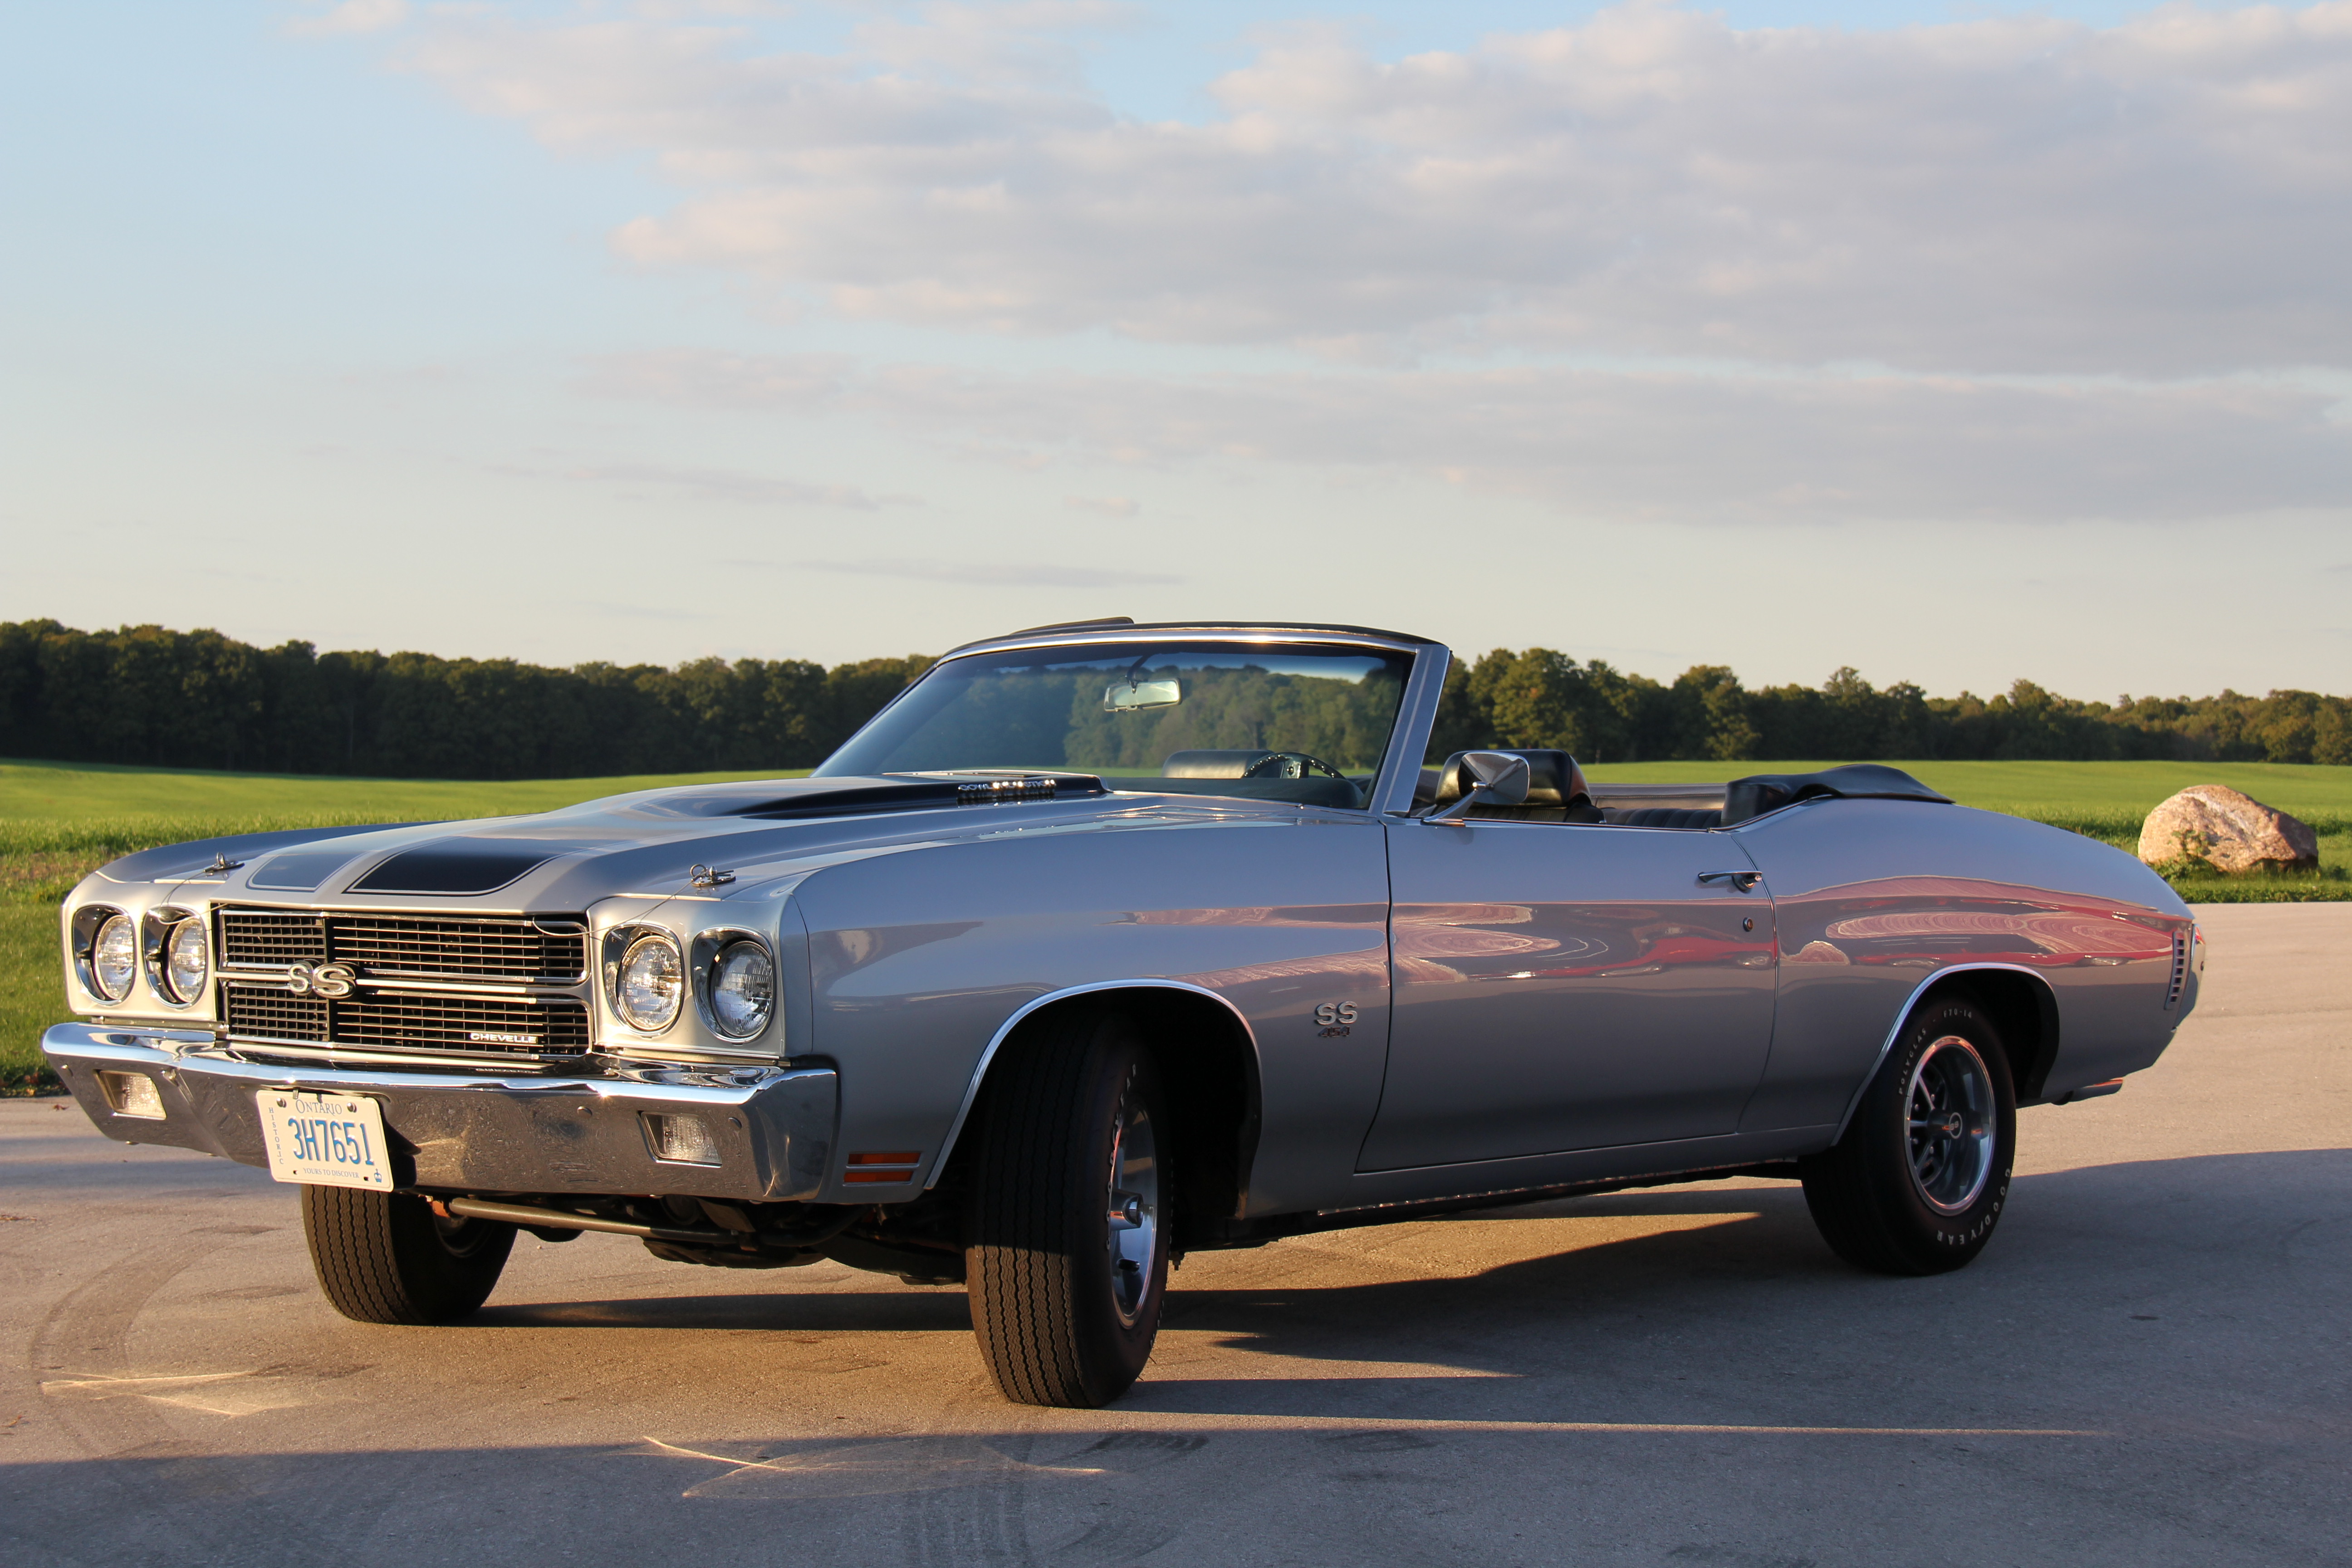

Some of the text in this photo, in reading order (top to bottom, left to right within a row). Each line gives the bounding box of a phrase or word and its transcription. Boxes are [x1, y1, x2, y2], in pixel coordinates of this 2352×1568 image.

[288, 962, 355, 998] SS
[1315, 1001, 1358, 1025] SS
[1943, 1008, 1972, 1019] F70-14
[470, 1033, 538, 1044] CHEVELLE
[1318, 1026, 1351, 1038] 454
[1898, 1028, 1926, 1095] POLYGLAS
[269, 1107, 284, 1165] HISTORIC
[288, 1118, 375, 1166] 3H7651
[331, 1170, 359, 1178] DISCOVER
[1937, 1168, 2011, 1245] GOODYEAR
